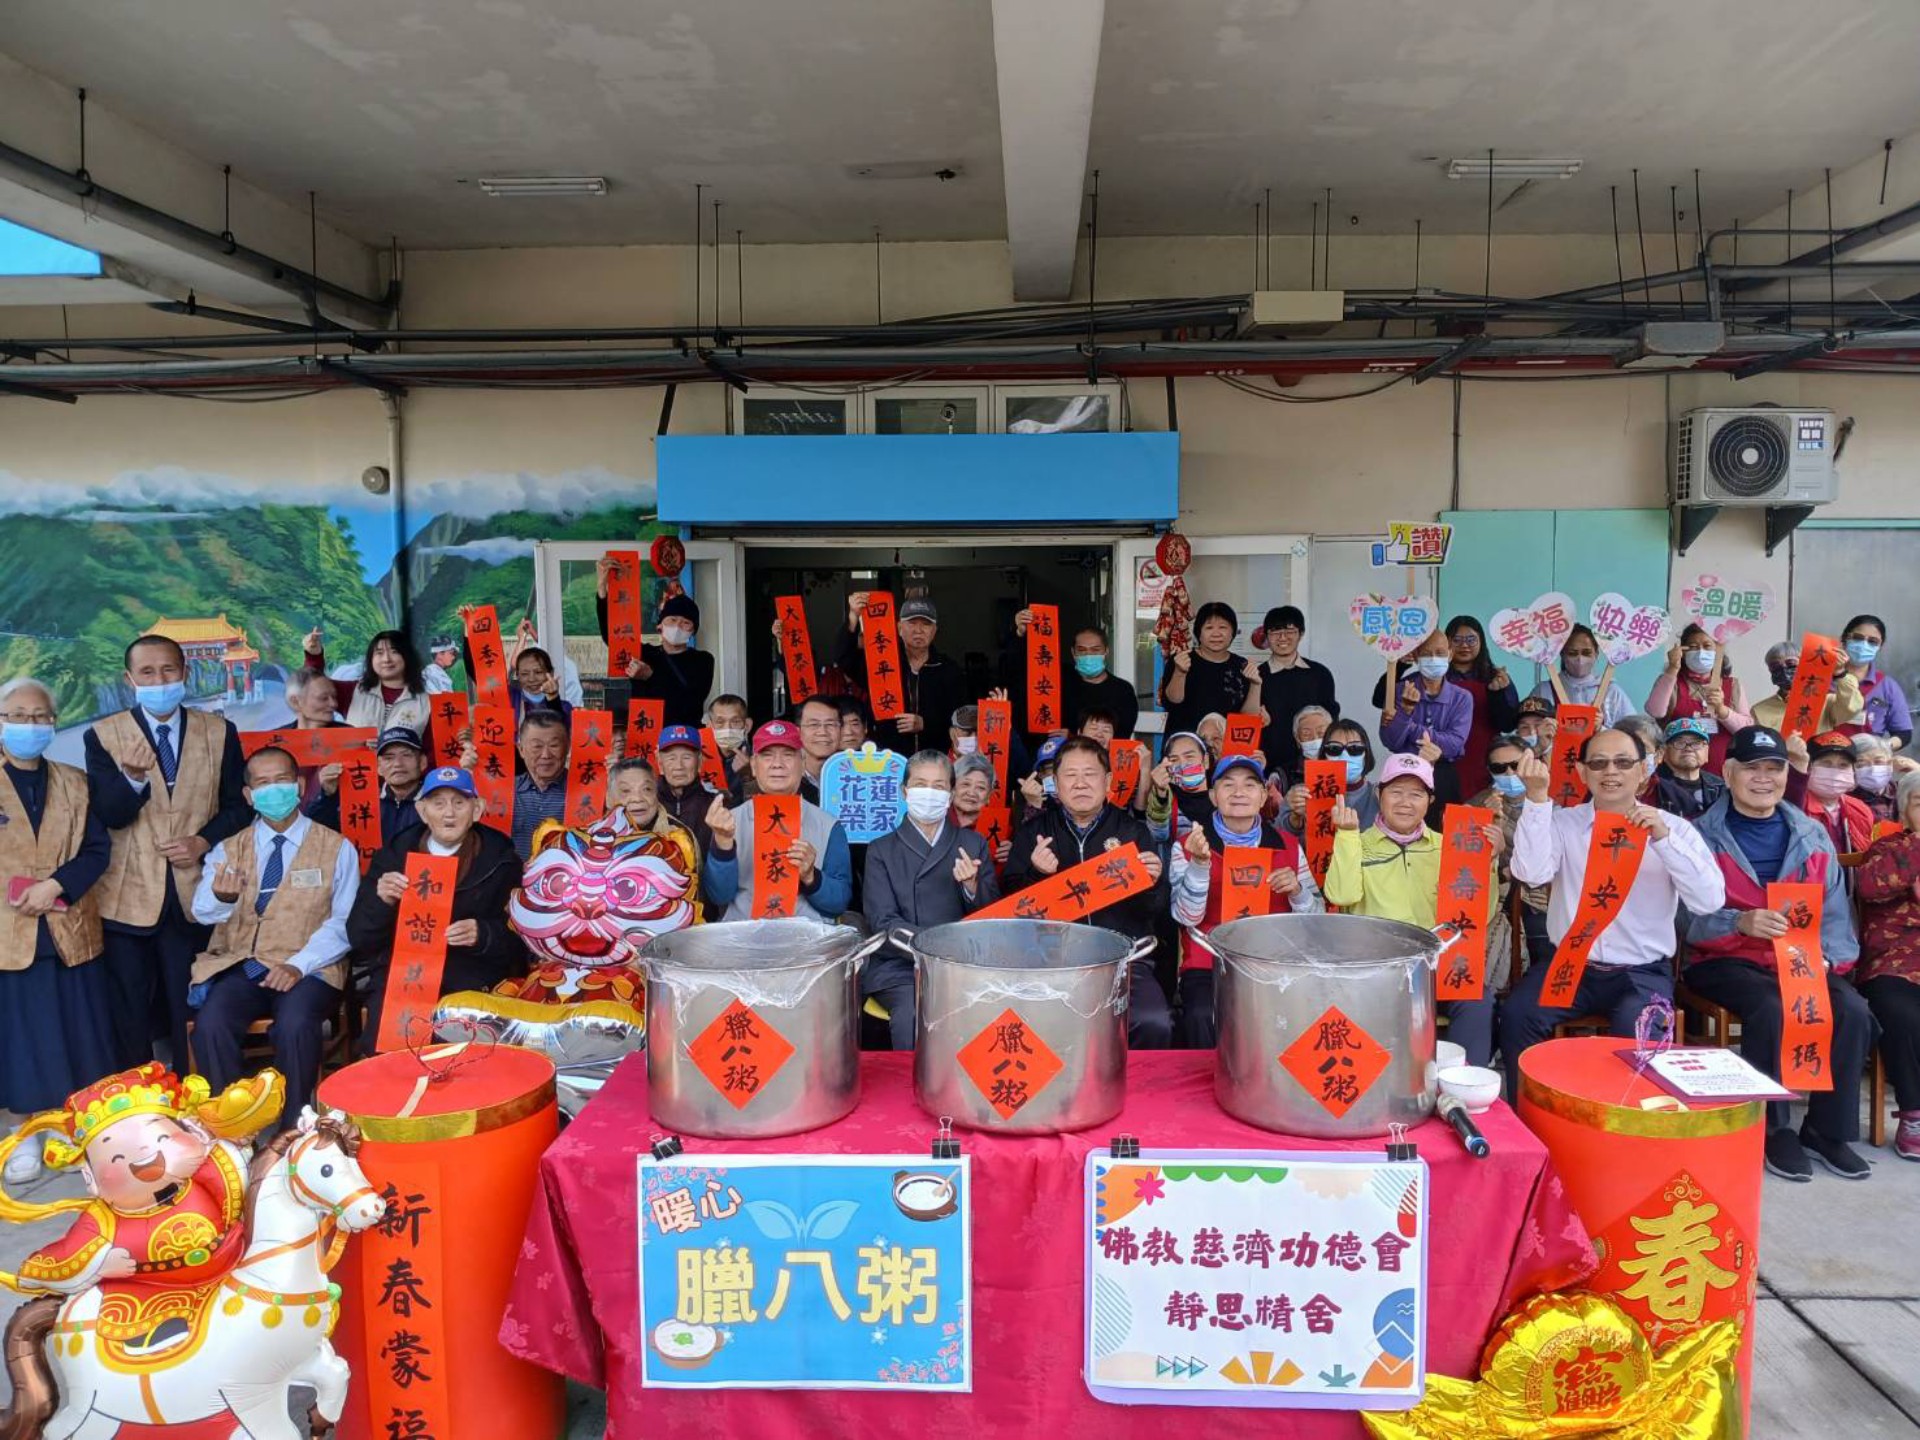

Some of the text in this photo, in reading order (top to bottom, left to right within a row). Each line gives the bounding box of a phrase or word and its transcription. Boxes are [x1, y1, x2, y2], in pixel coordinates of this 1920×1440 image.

[1411, 527, 1442, 557] 讚
[1362, 606, 1427, 637] 感恩
[1501, 603, 1569, 648] 幸福
[1596, 603, 1660, 648] 快樂
[1691, 587, 1763, 621] 溫暖
[472, 616, 502, 707] 四季平
[867, 602, 897, 712] 四季平安
[1033, 613, 1055, 727] 福壽安康
[438, 701, 465, 759] 平安
[1231, 727, 1255, 744] 四
[839, 775, 898, 802] 花蓮
[839, 804, 898, 831] 榮家
[1444, 816, 1484, 989] 福壽安康
[1551, 828, 1636, 995] 平安喜樂
[717, 1010, 761, 1095] 臘八粥
[988, 1022, 1031, 1108] 臘八粥
[1313, 1020, 1363, 1103] 臘八粥
[651, 1180, 743, 1234] 暖心
[1098, 1226, 1412, 1273] 佛教慈濟功德會
[1615, 1200, 1740, 1323] 春
[676, 1247, 939, 1326] 臘八粥
[1163, 1290, 1343, 1335] 靜思精舍
